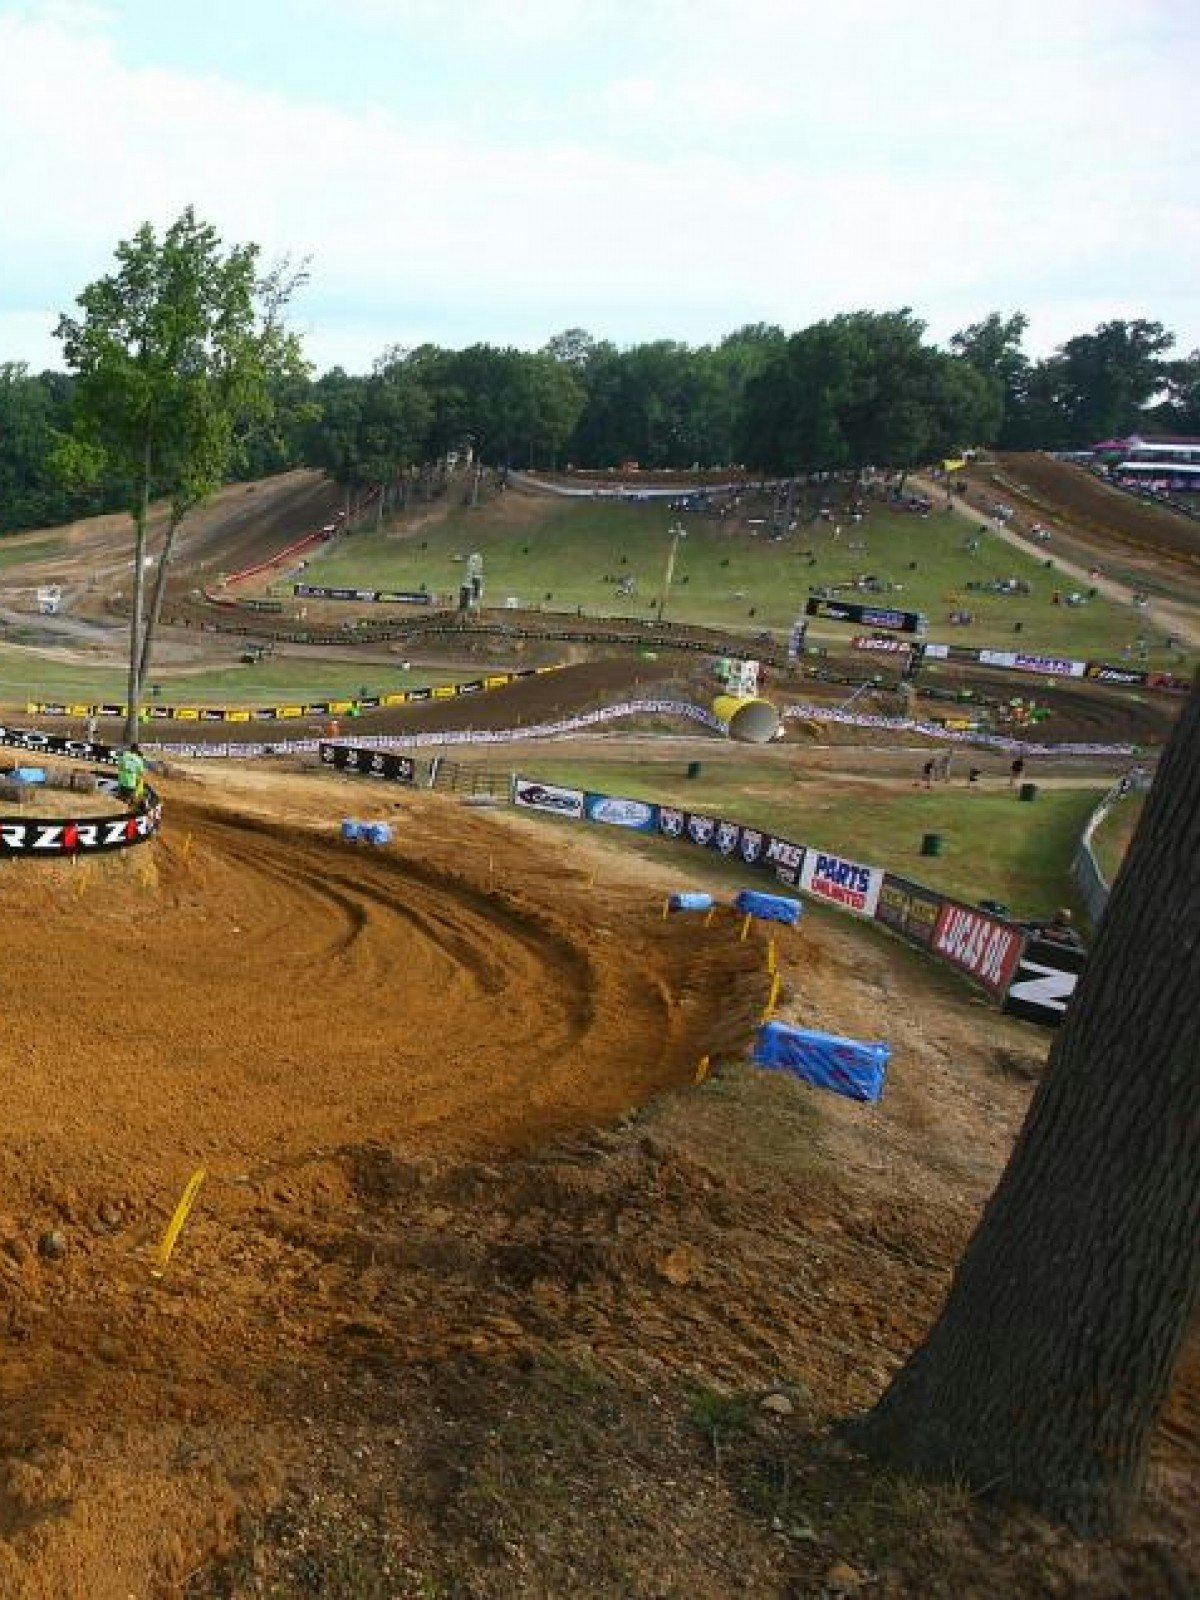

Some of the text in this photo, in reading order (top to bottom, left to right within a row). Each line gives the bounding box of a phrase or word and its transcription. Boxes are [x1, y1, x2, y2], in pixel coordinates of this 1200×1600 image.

[814, 853, 871, 892] PARTS
[810, 877, 866, 910] UNLIMITED
[937, 904, 991, 969] LUCAS
[980, 926, 1013, 986] OIL
